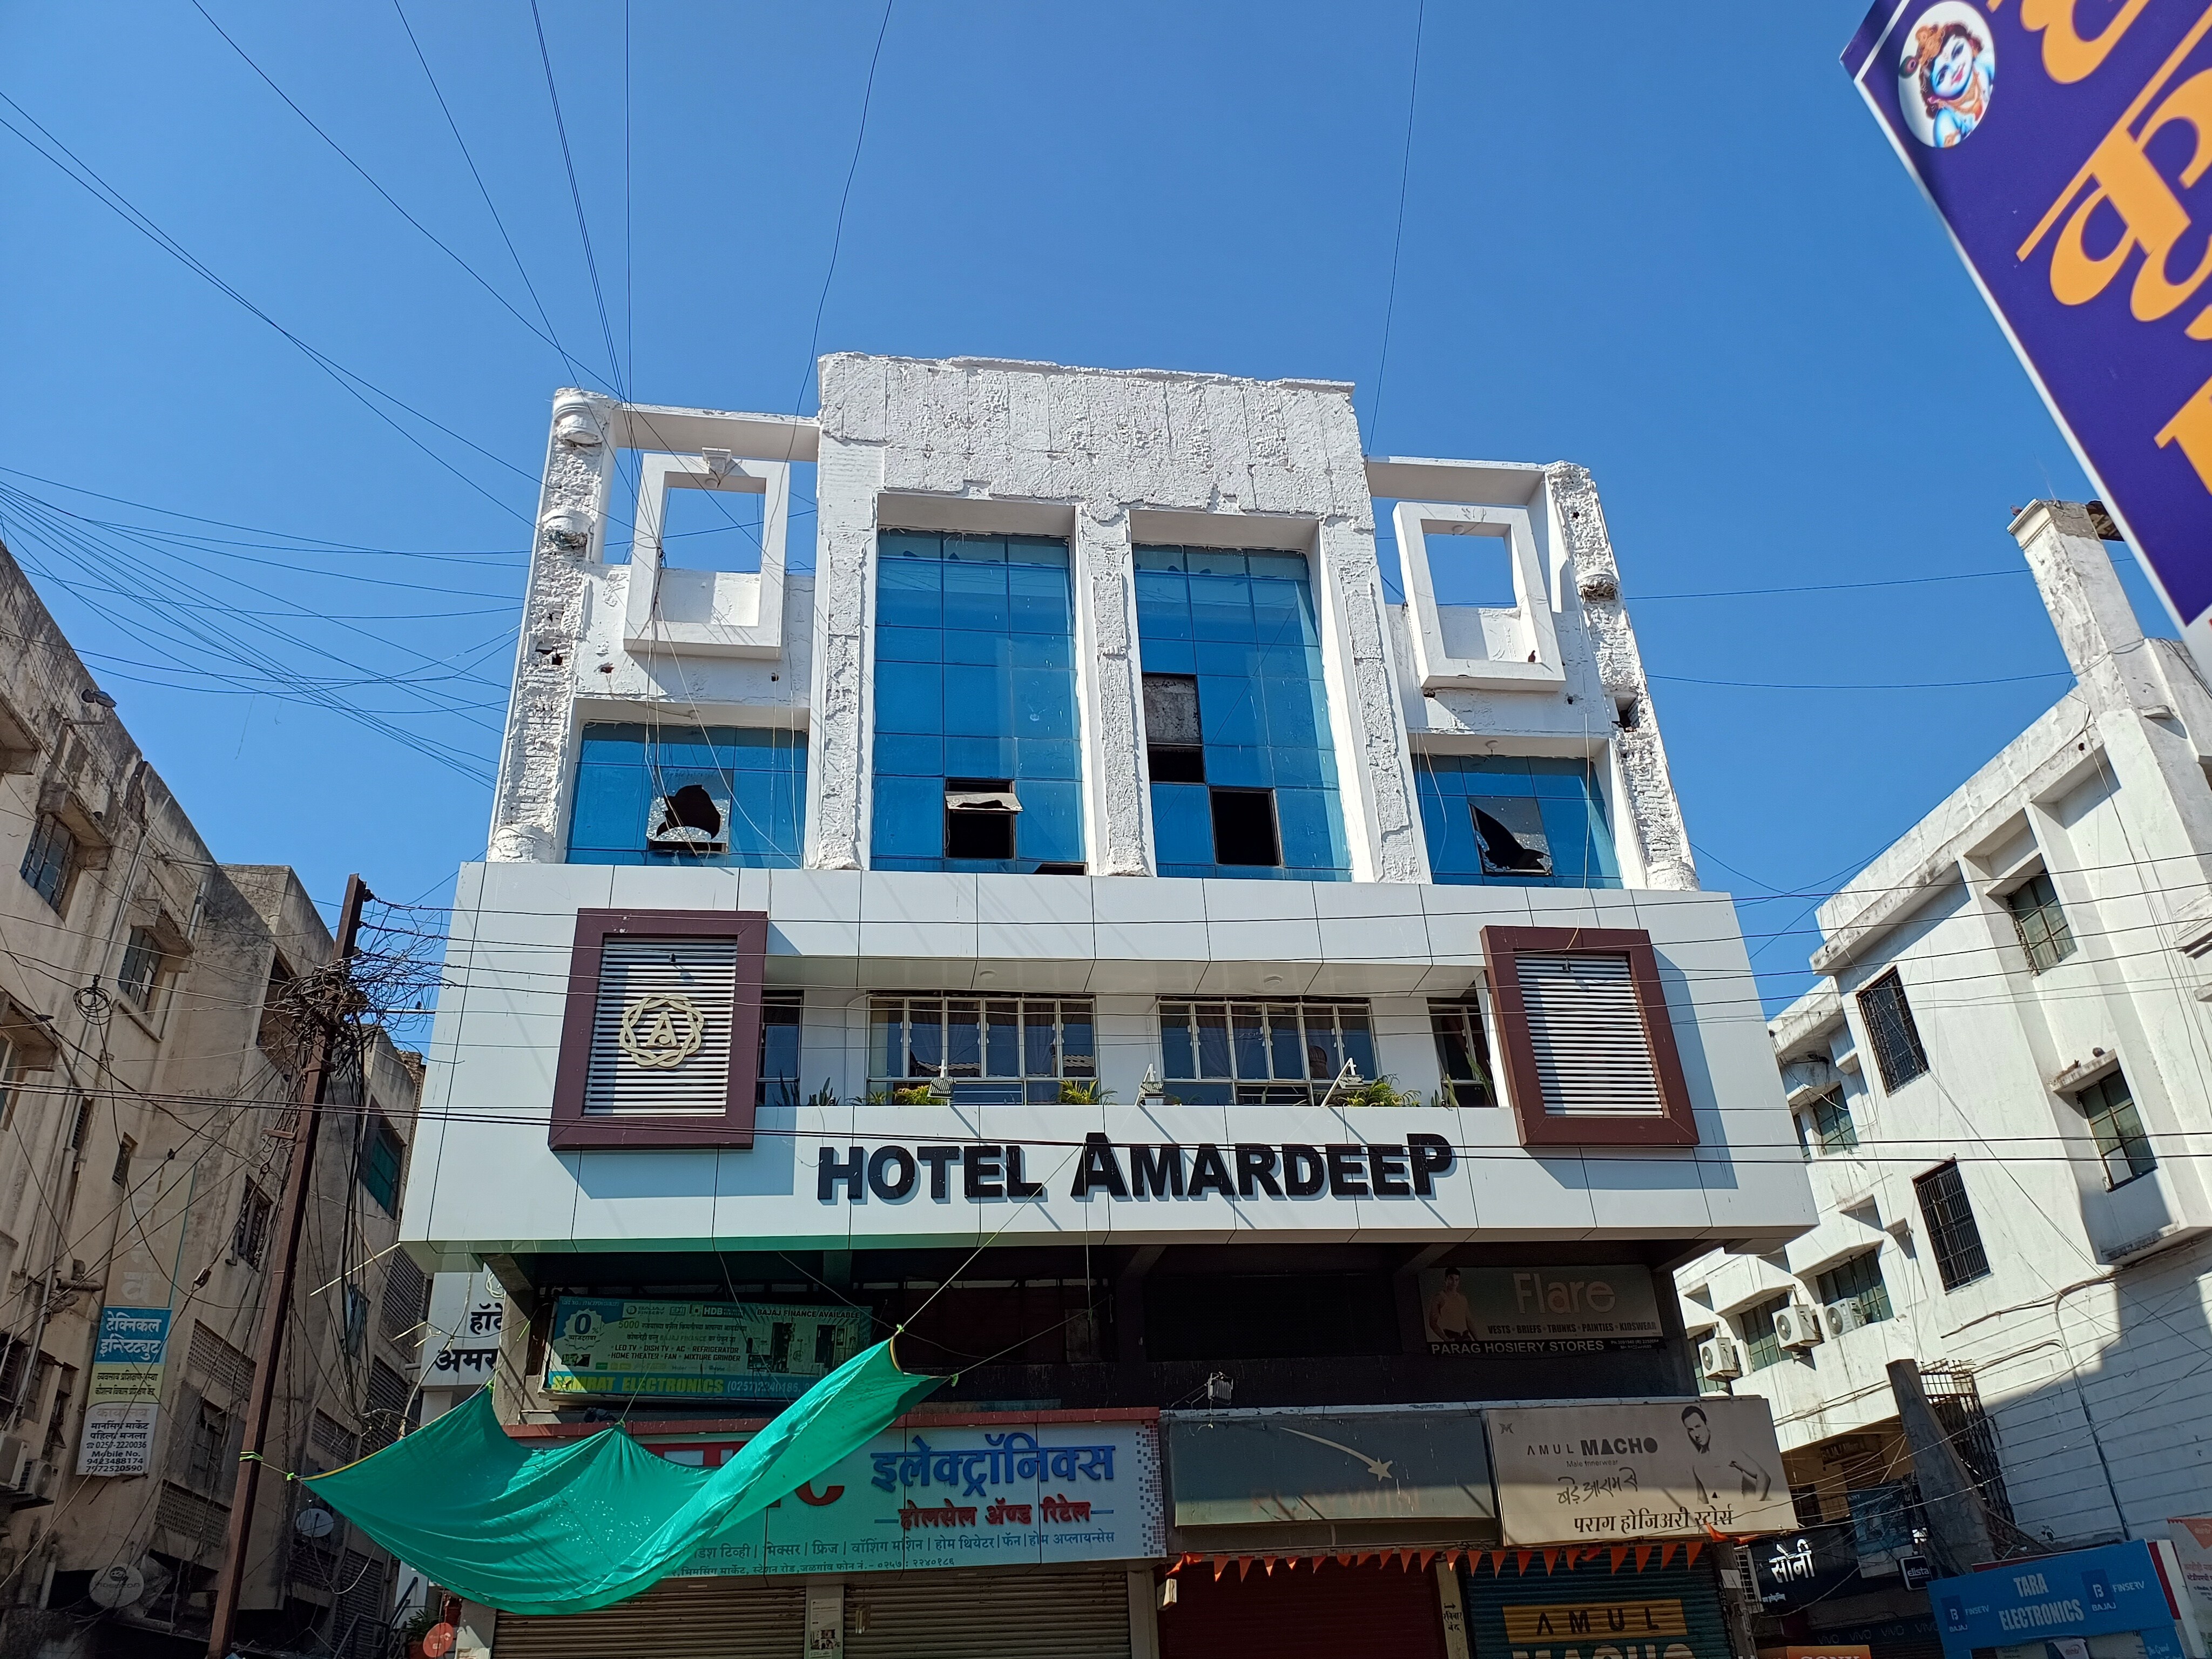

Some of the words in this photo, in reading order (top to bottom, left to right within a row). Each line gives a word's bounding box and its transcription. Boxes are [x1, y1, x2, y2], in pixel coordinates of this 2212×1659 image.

[818, 1144, 1043, 1201] HOTEL
[1071, 1133, 1453, 1198] AMARDEEP
[1513, 1272, 1616, 1314] Flare
[704, 1307, 723, 1315] HDB
[757, 1309, 781, 1317] BAJAJ
[783, 1310, 817, 1318] FINANCE
[818, 1311, 860, 1319] AVAILABLE
[618, 1320, 640, 1329] 5000
[1487, 1325, 1511, 1334] VESTS
[1516, 1325, 1542, 1334] BRIEFS
[1547, 1324, 1576, 1333] TRUNKS
[1431, 1343, 1481, 1354] PARAG
[1485, 1341, 1545, 1353] HOSIERY
[1549, 1340, 1604, 1351] STORES
[551, 1375, 616, 1392] SAMRAT
[621, 1377, 724, 1393] ELECTRONICS
[1527, 1443, 1574, 1455] AMUL
[1580, 1437, 1658, 1456] MACHO
[1574, 1515, 1617, 1533] पराग
[934, 1534, 956, 1550] होम
[959, 1534, 995, 1549] थियेटर
[1028, 1530, 1049, 1547] होम
[837, 1560, 854, 1571] फोन
[1768, 1539, 1815, 1583] सोनी
[2013, 1573, 2049, 1597] TARA
[2112, 1580, 2145, 1593] FINSERV
[1965, 1604, 1990, 1615] FINSERV
[2091, 1602, 2116, 1611] BAJAJ
[1536, 1607, 1660, 1635] AMUL
[1998, 1599, 2085, 1631] ELECTRONICS
[1948, 1623, 1968, 1633] BAJAJ
